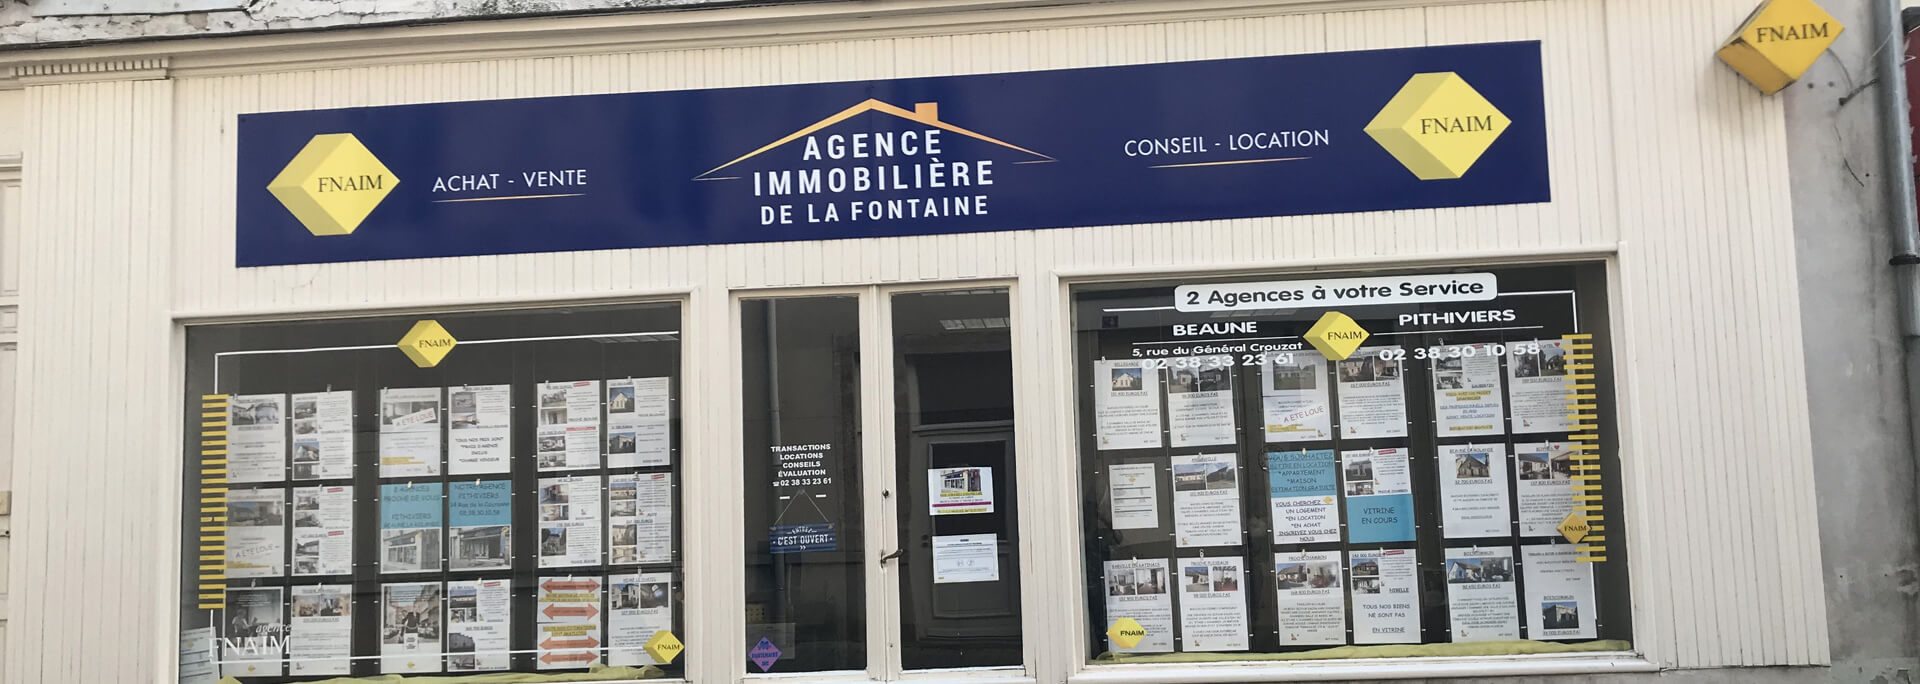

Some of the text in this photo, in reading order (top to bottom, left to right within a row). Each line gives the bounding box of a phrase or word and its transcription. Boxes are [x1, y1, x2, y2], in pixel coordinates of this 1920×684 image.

[1756, 22, 1830, 43] FNAIM
[1420, 115, 1493, 135] FNAIM
[803, 129, 942, 161] AGENCE
[1124, 137, 1207, 157] CONSEIL
[1229, 129, 1330, 151] LOCATION
[317, 174, 384, 194] FNAIM
[432, 173, 500, 193] ACHAT
[523, 169, 588, 188] VENTE
[754, 157, 994, 197] IMMOBILIÈRE
[760, 195, 989, 226] DE LA FONTAINE
[1186, 280, 1484, 308] 2 Agences à votre Service
[1398, 308, 1517, 326] PITHIVIERS
[1172, 321, 1258, 337] BEAUNE
[1327, 330, 1363, 341] FNAIM
[418, 338, 452, 349] FNAIM
[1132, 341, 1304, 358] 5, rue du Général Crouzat
[1379, 342, 1541, 362] 02 38 30 10 58
[1141, 352, 1295, 371] 02 38 33 23 61
[770, 443, 832, 453] TRANSACTIONS
[780, 452, 824, 461] LOCATIONS
[782, 460, 821, 469] CONSEILS
[780, 477, 832, 487] 02 38 33 23 61
[1363, 507, 1395, 515] VITRINE
[1361, 516, 1399, 525] EN COURS
[800, 534, 829, 545] OUVERT
[1120, 629, 1145, 637] FNAIM
[1372, 625, 1406, 634] EN VITRINE
[208, 634, 291, 659] FNAIM
